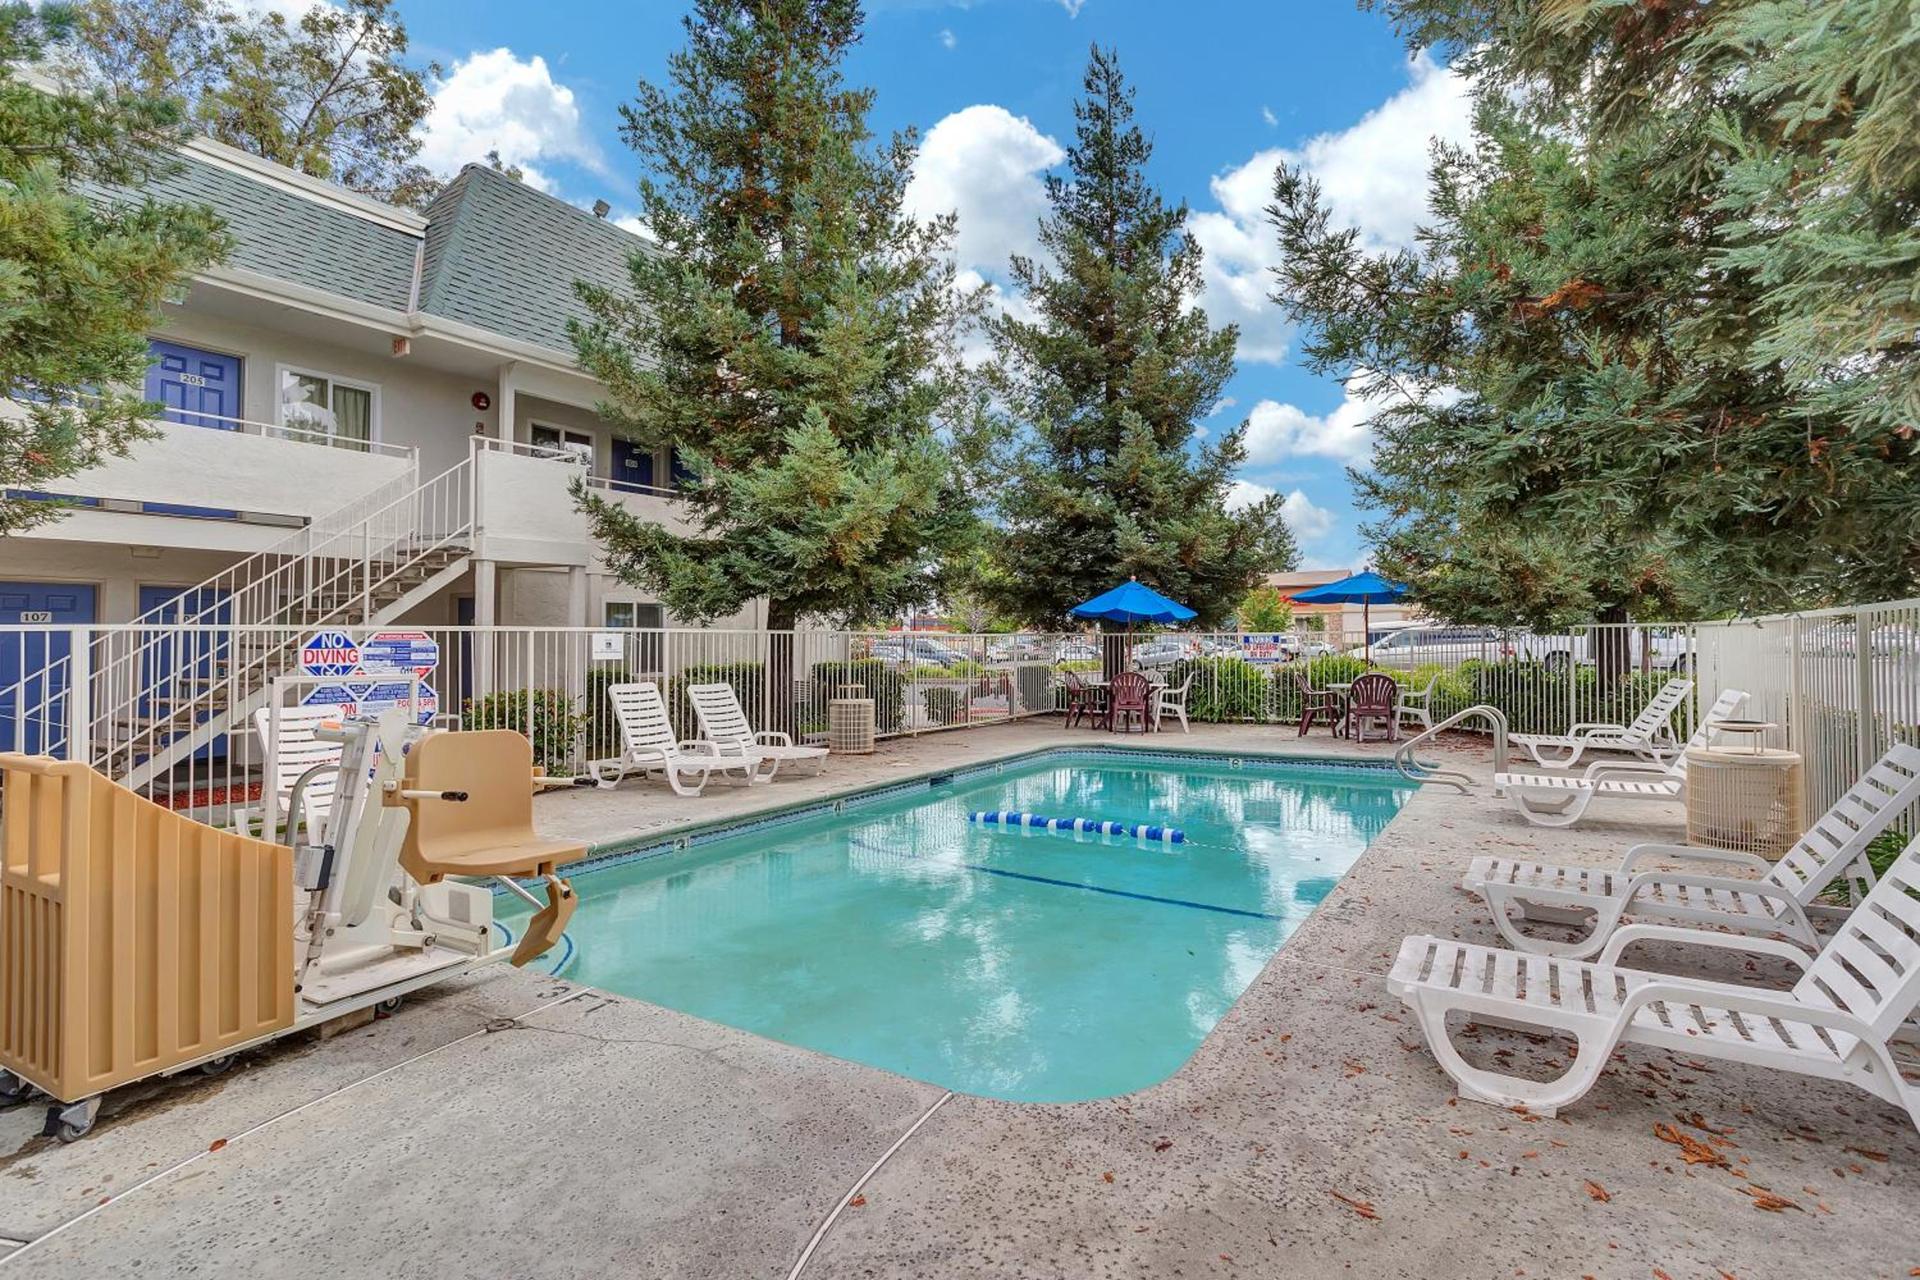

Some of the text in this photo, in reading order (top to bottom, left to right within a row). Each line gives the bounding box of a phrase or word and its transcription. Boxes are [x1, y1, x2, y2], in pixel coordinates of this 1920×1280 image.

[182, 374, 203, 385] 205
[24, 612, 48, 621] 107
[321, 633, 345, 649] NO
[303, 649, 359, 664] DIVING
